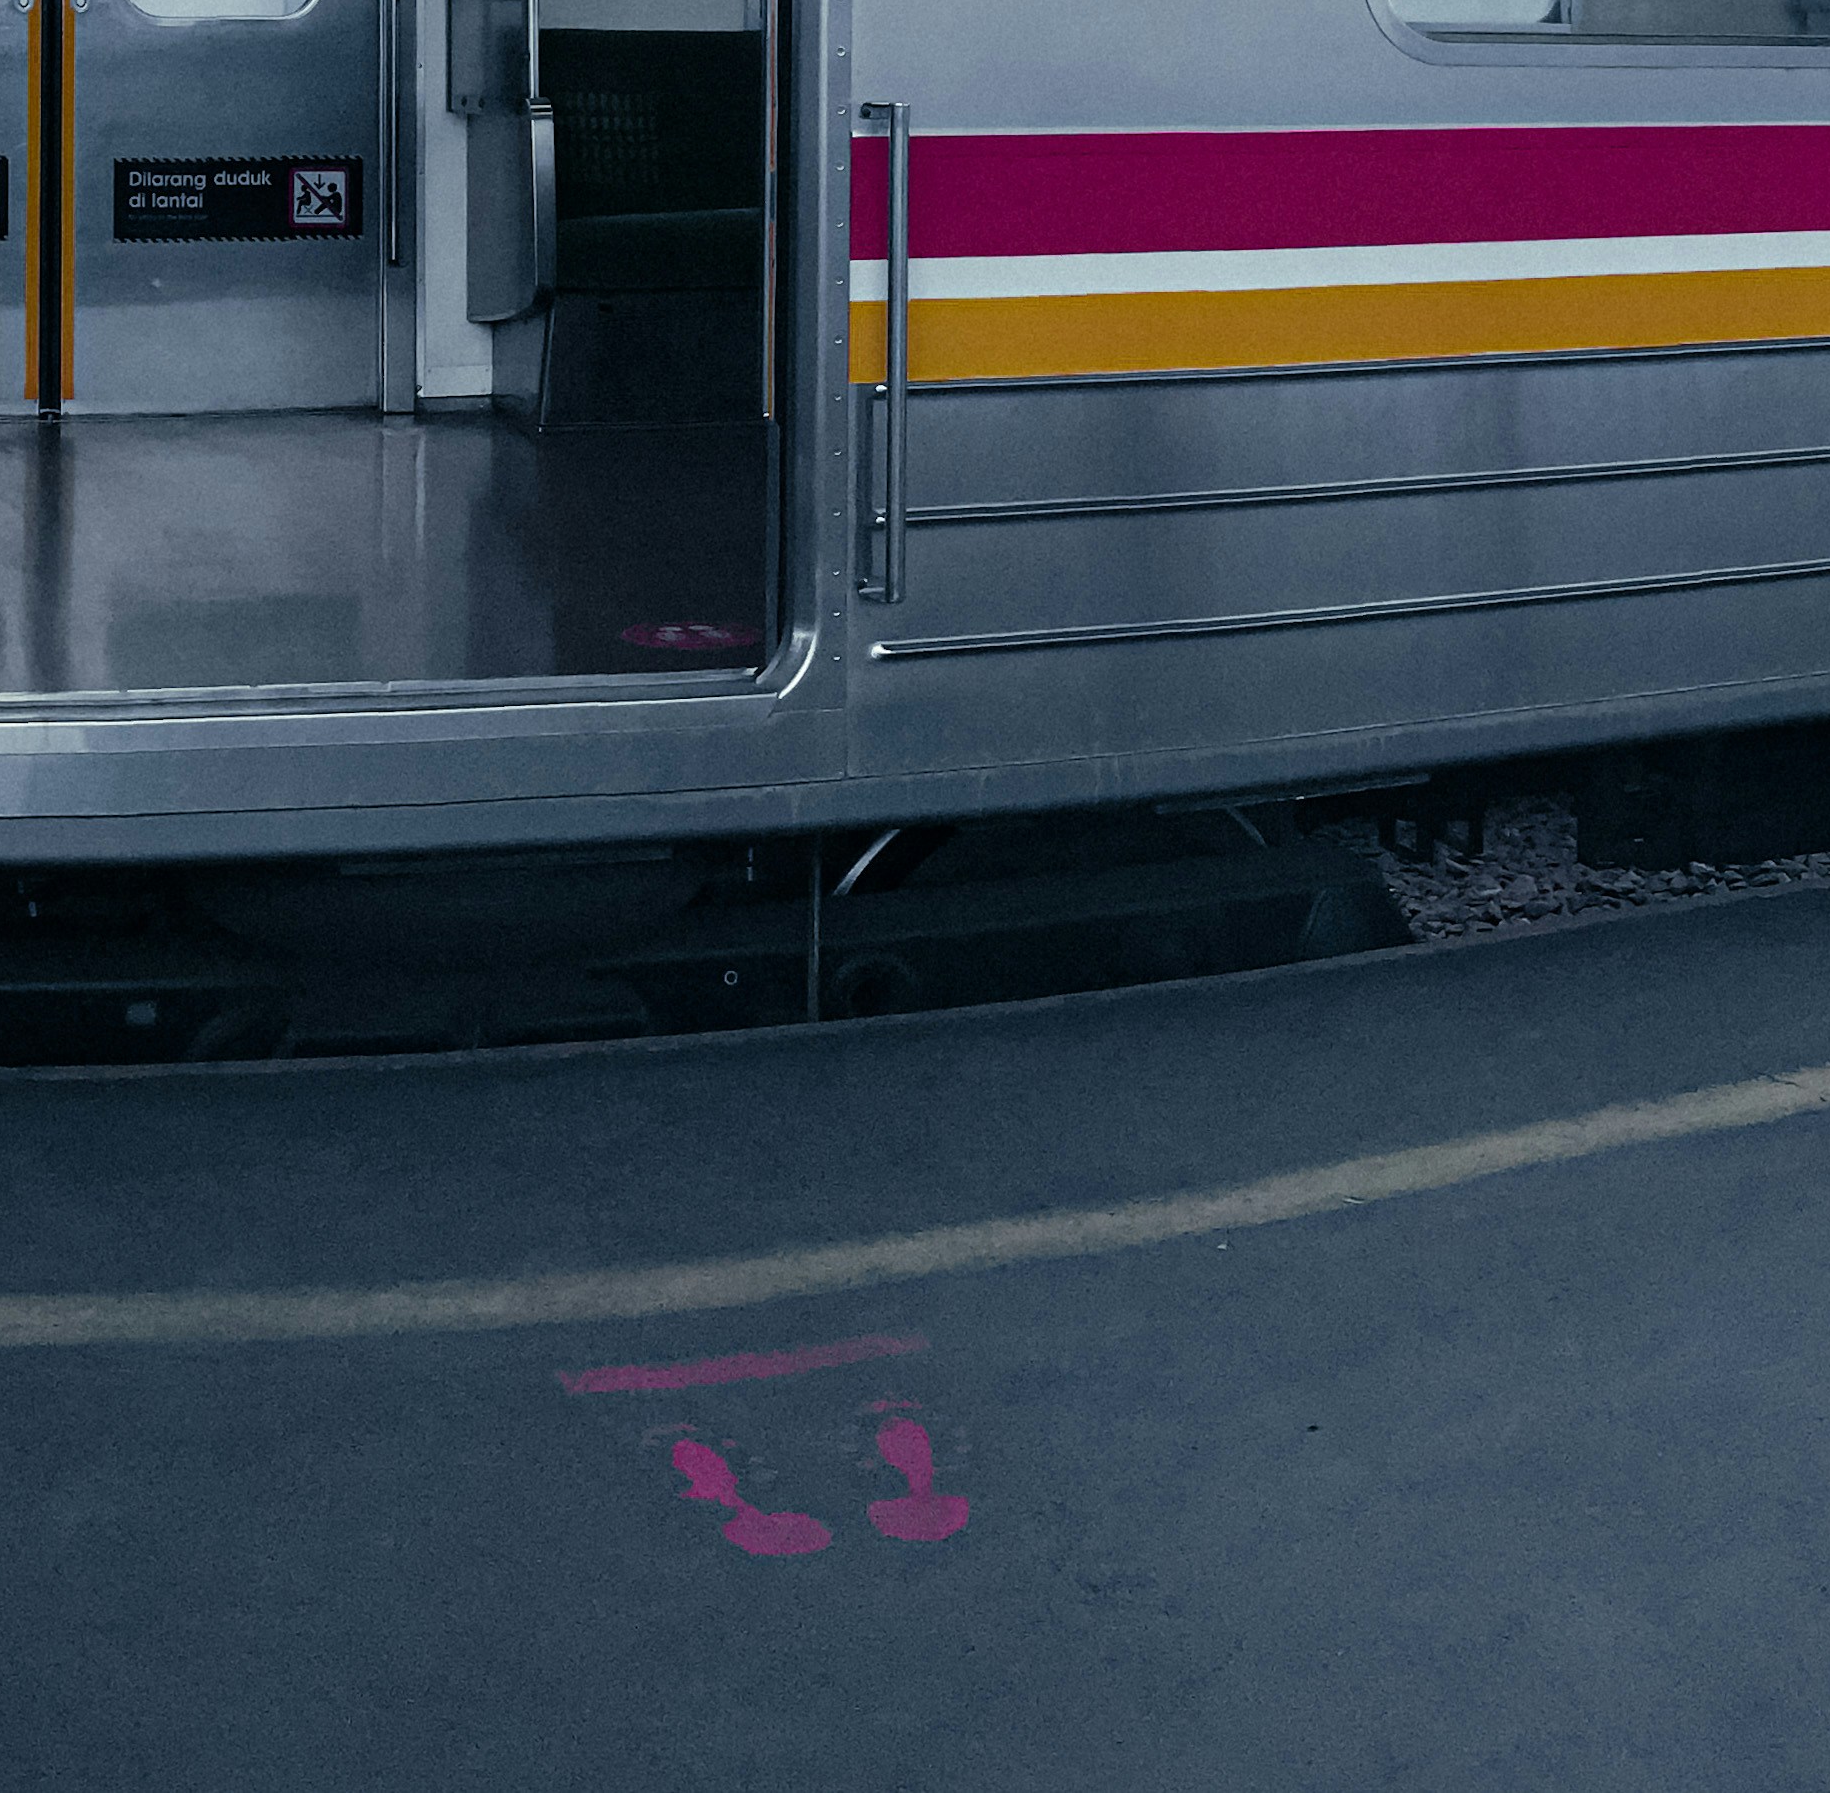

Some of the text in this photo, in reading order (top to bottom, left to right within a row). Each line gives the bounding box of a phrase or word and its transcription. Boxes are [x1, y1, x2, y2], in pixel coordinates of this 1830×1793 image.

[127, 168, 273, 192] Dilarang duduk
[127, 191, 204, 209] di lantai
